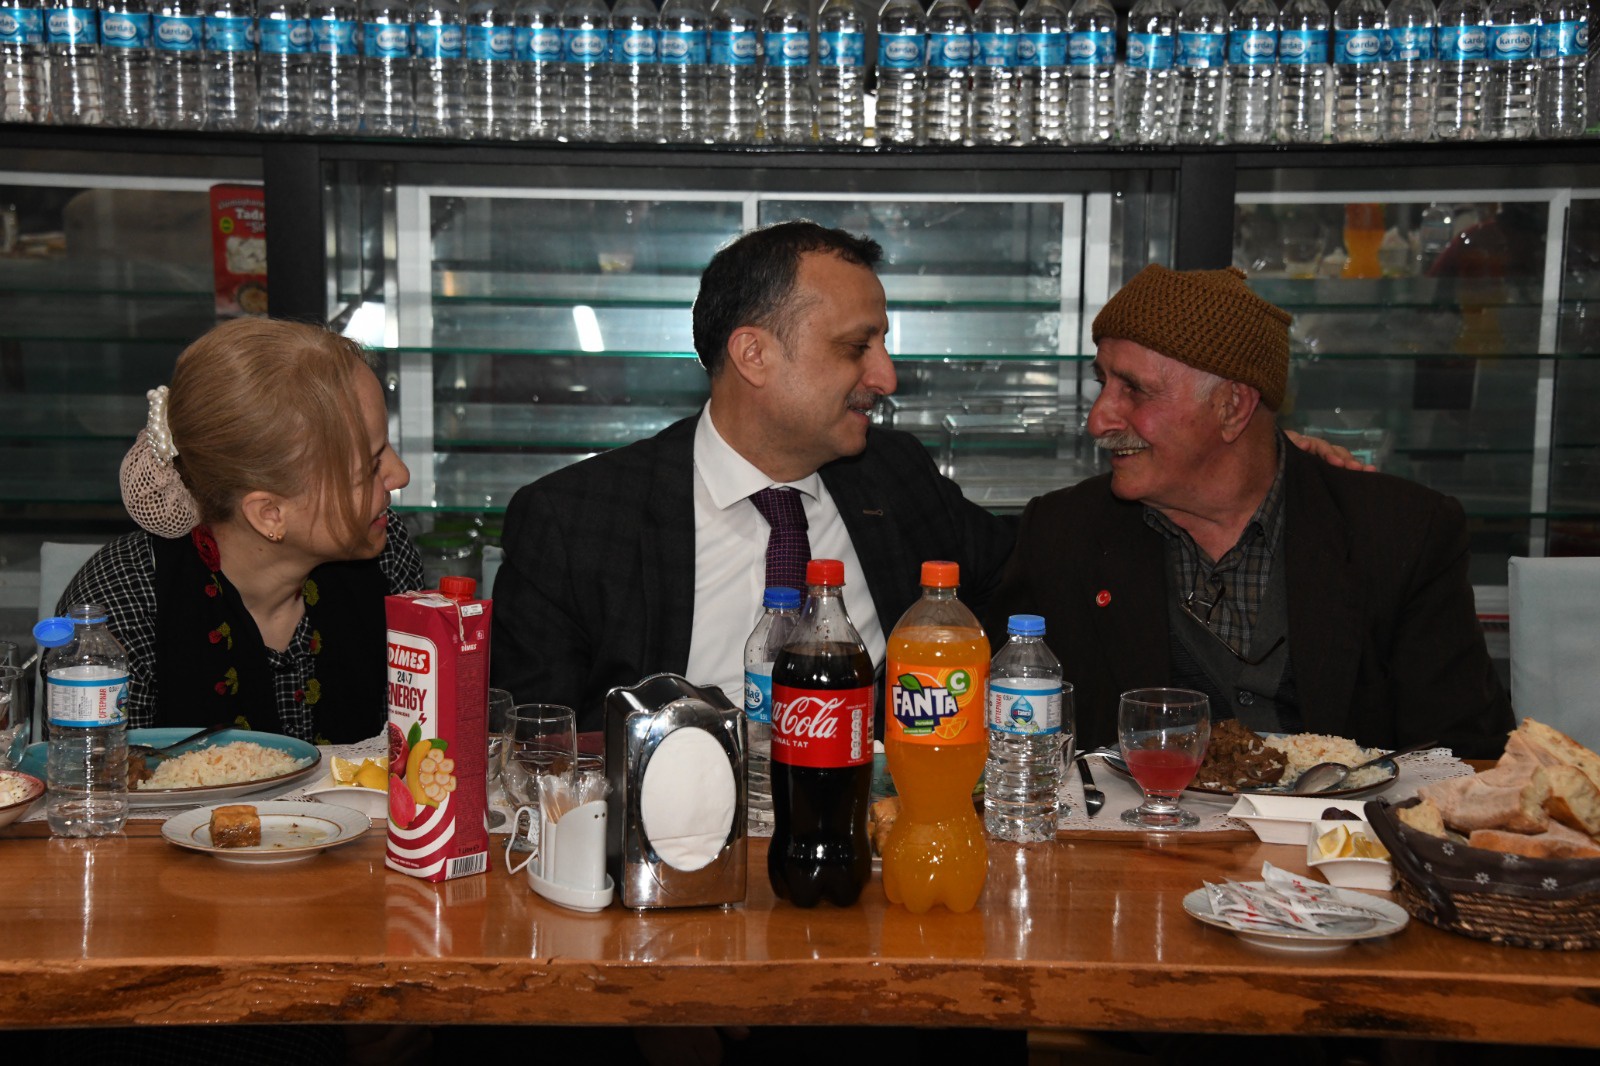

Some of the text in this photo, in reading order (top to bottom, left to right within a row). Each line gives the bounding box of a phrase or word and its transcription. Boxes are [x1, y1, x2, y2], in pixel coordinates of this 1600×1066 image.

[388, 645, 426, 670] DİMES
[950, 672, 965, 690] C
[388, 681, 427, 711] ENERGY
[892, 686, 958, 717] FANTA
[792, 740, 808, 749] TAT
